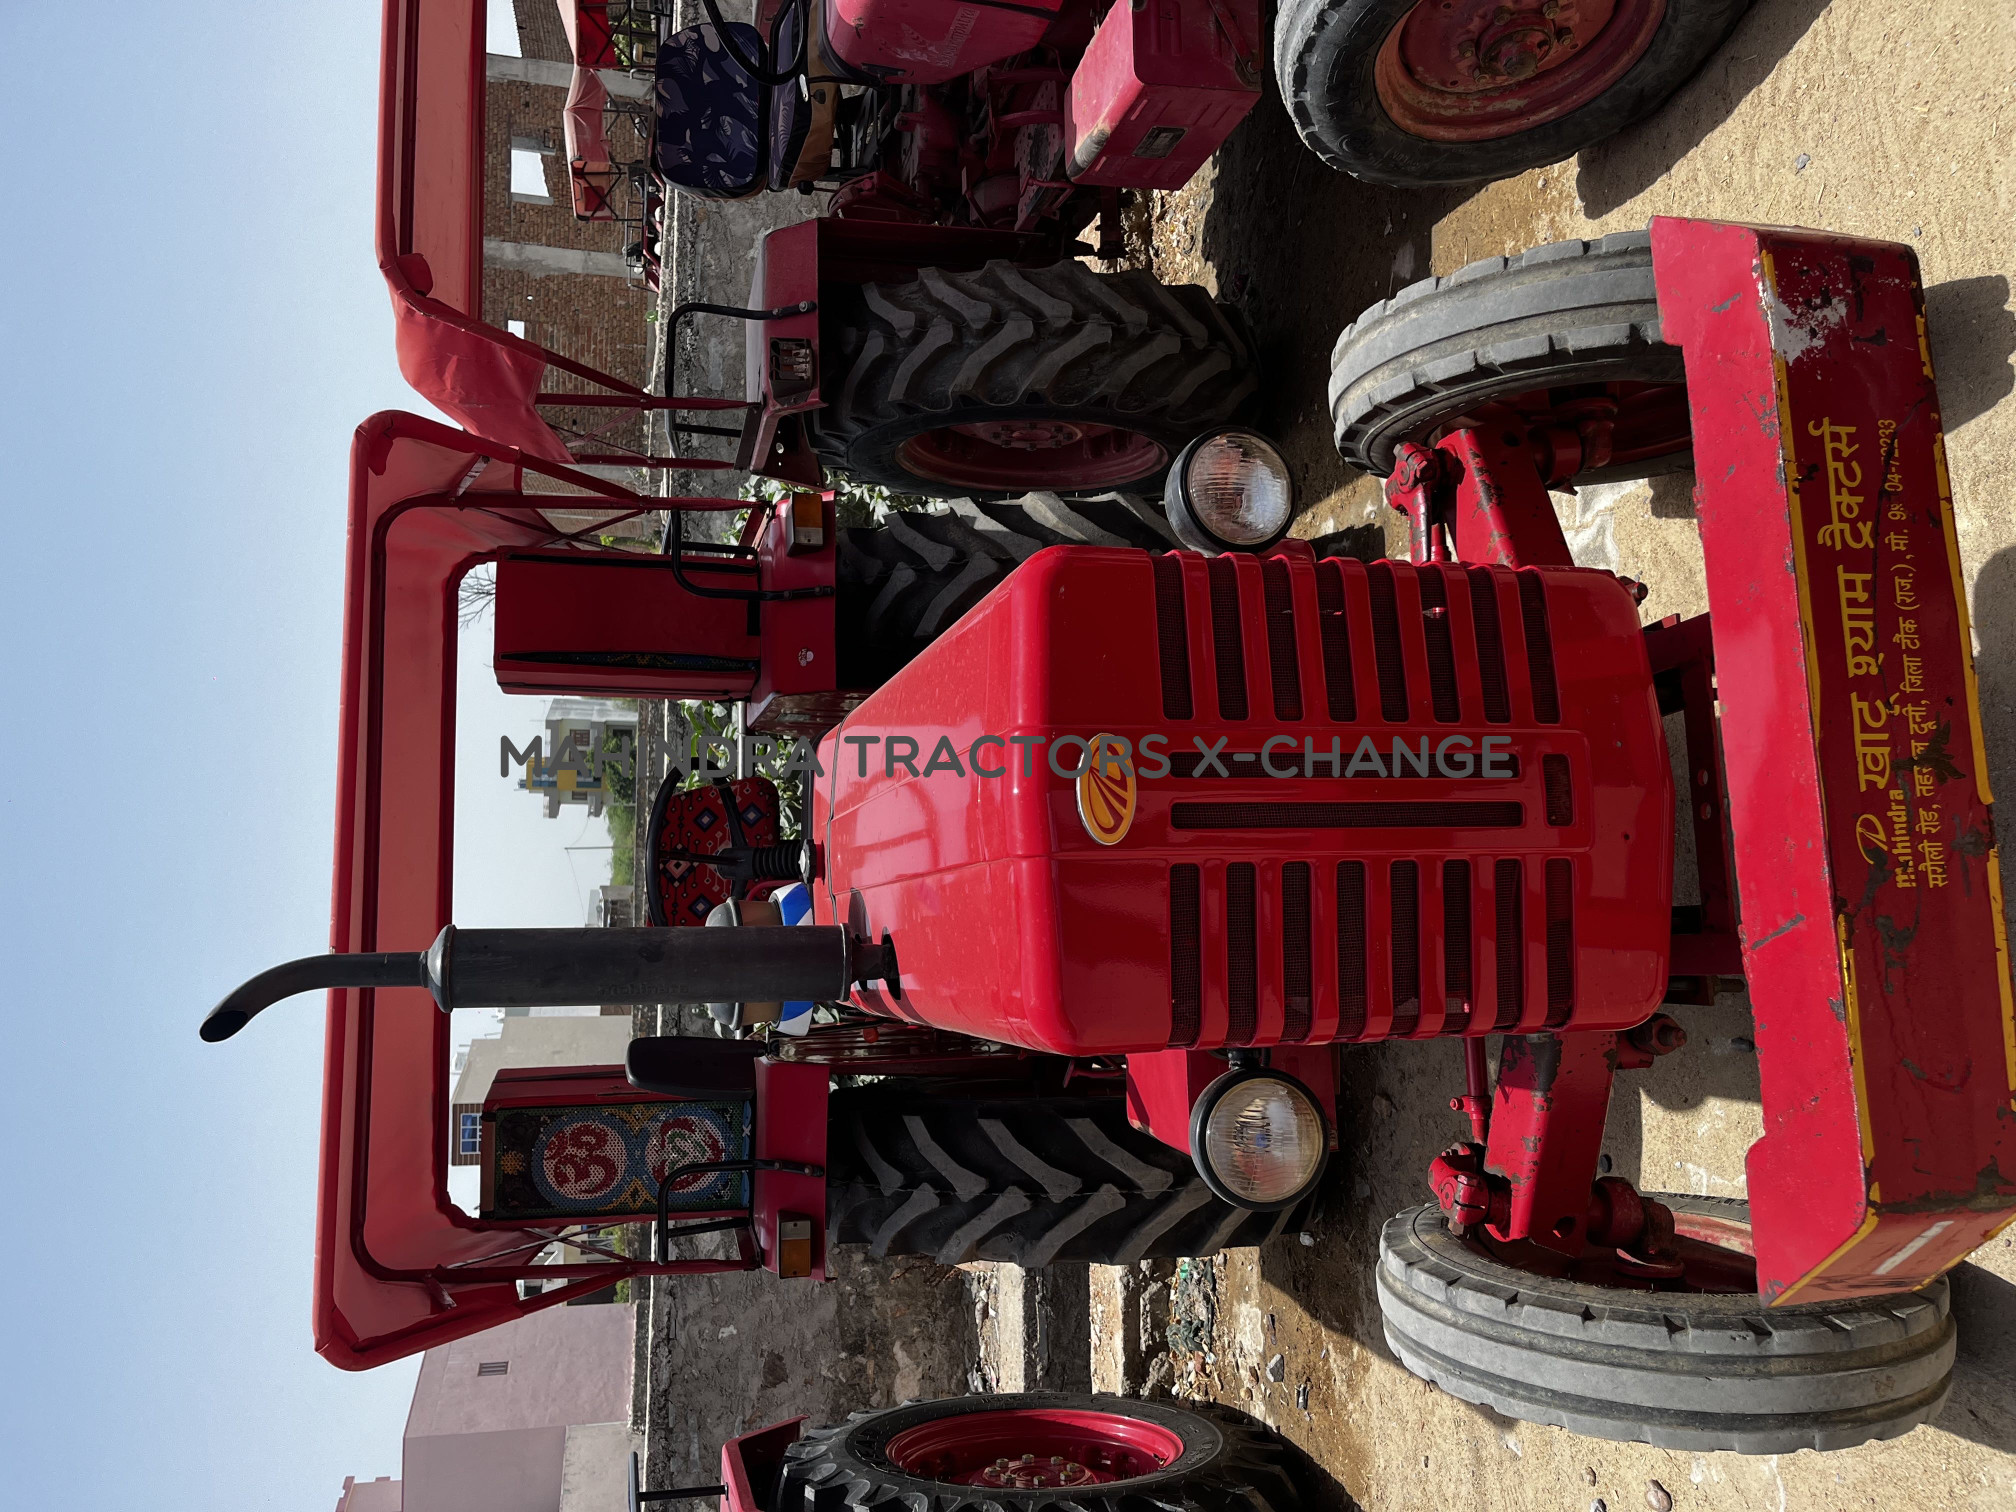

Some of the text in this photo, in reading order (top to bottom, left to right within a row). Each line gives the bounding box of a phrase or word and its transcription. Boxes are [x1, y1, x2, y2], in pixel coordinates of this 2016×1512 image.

[1808, 417, 1874, 551] ट्रैक्टर्स
[1885, 529, 1909, 551] मो.
[1837, 565, 1885, 678] श्याम
[1900, 654, 1924, 693] जिला
[1900, 700, 1937, 734] दूनी,
[1915, 804, 1941, 835] रोड,
